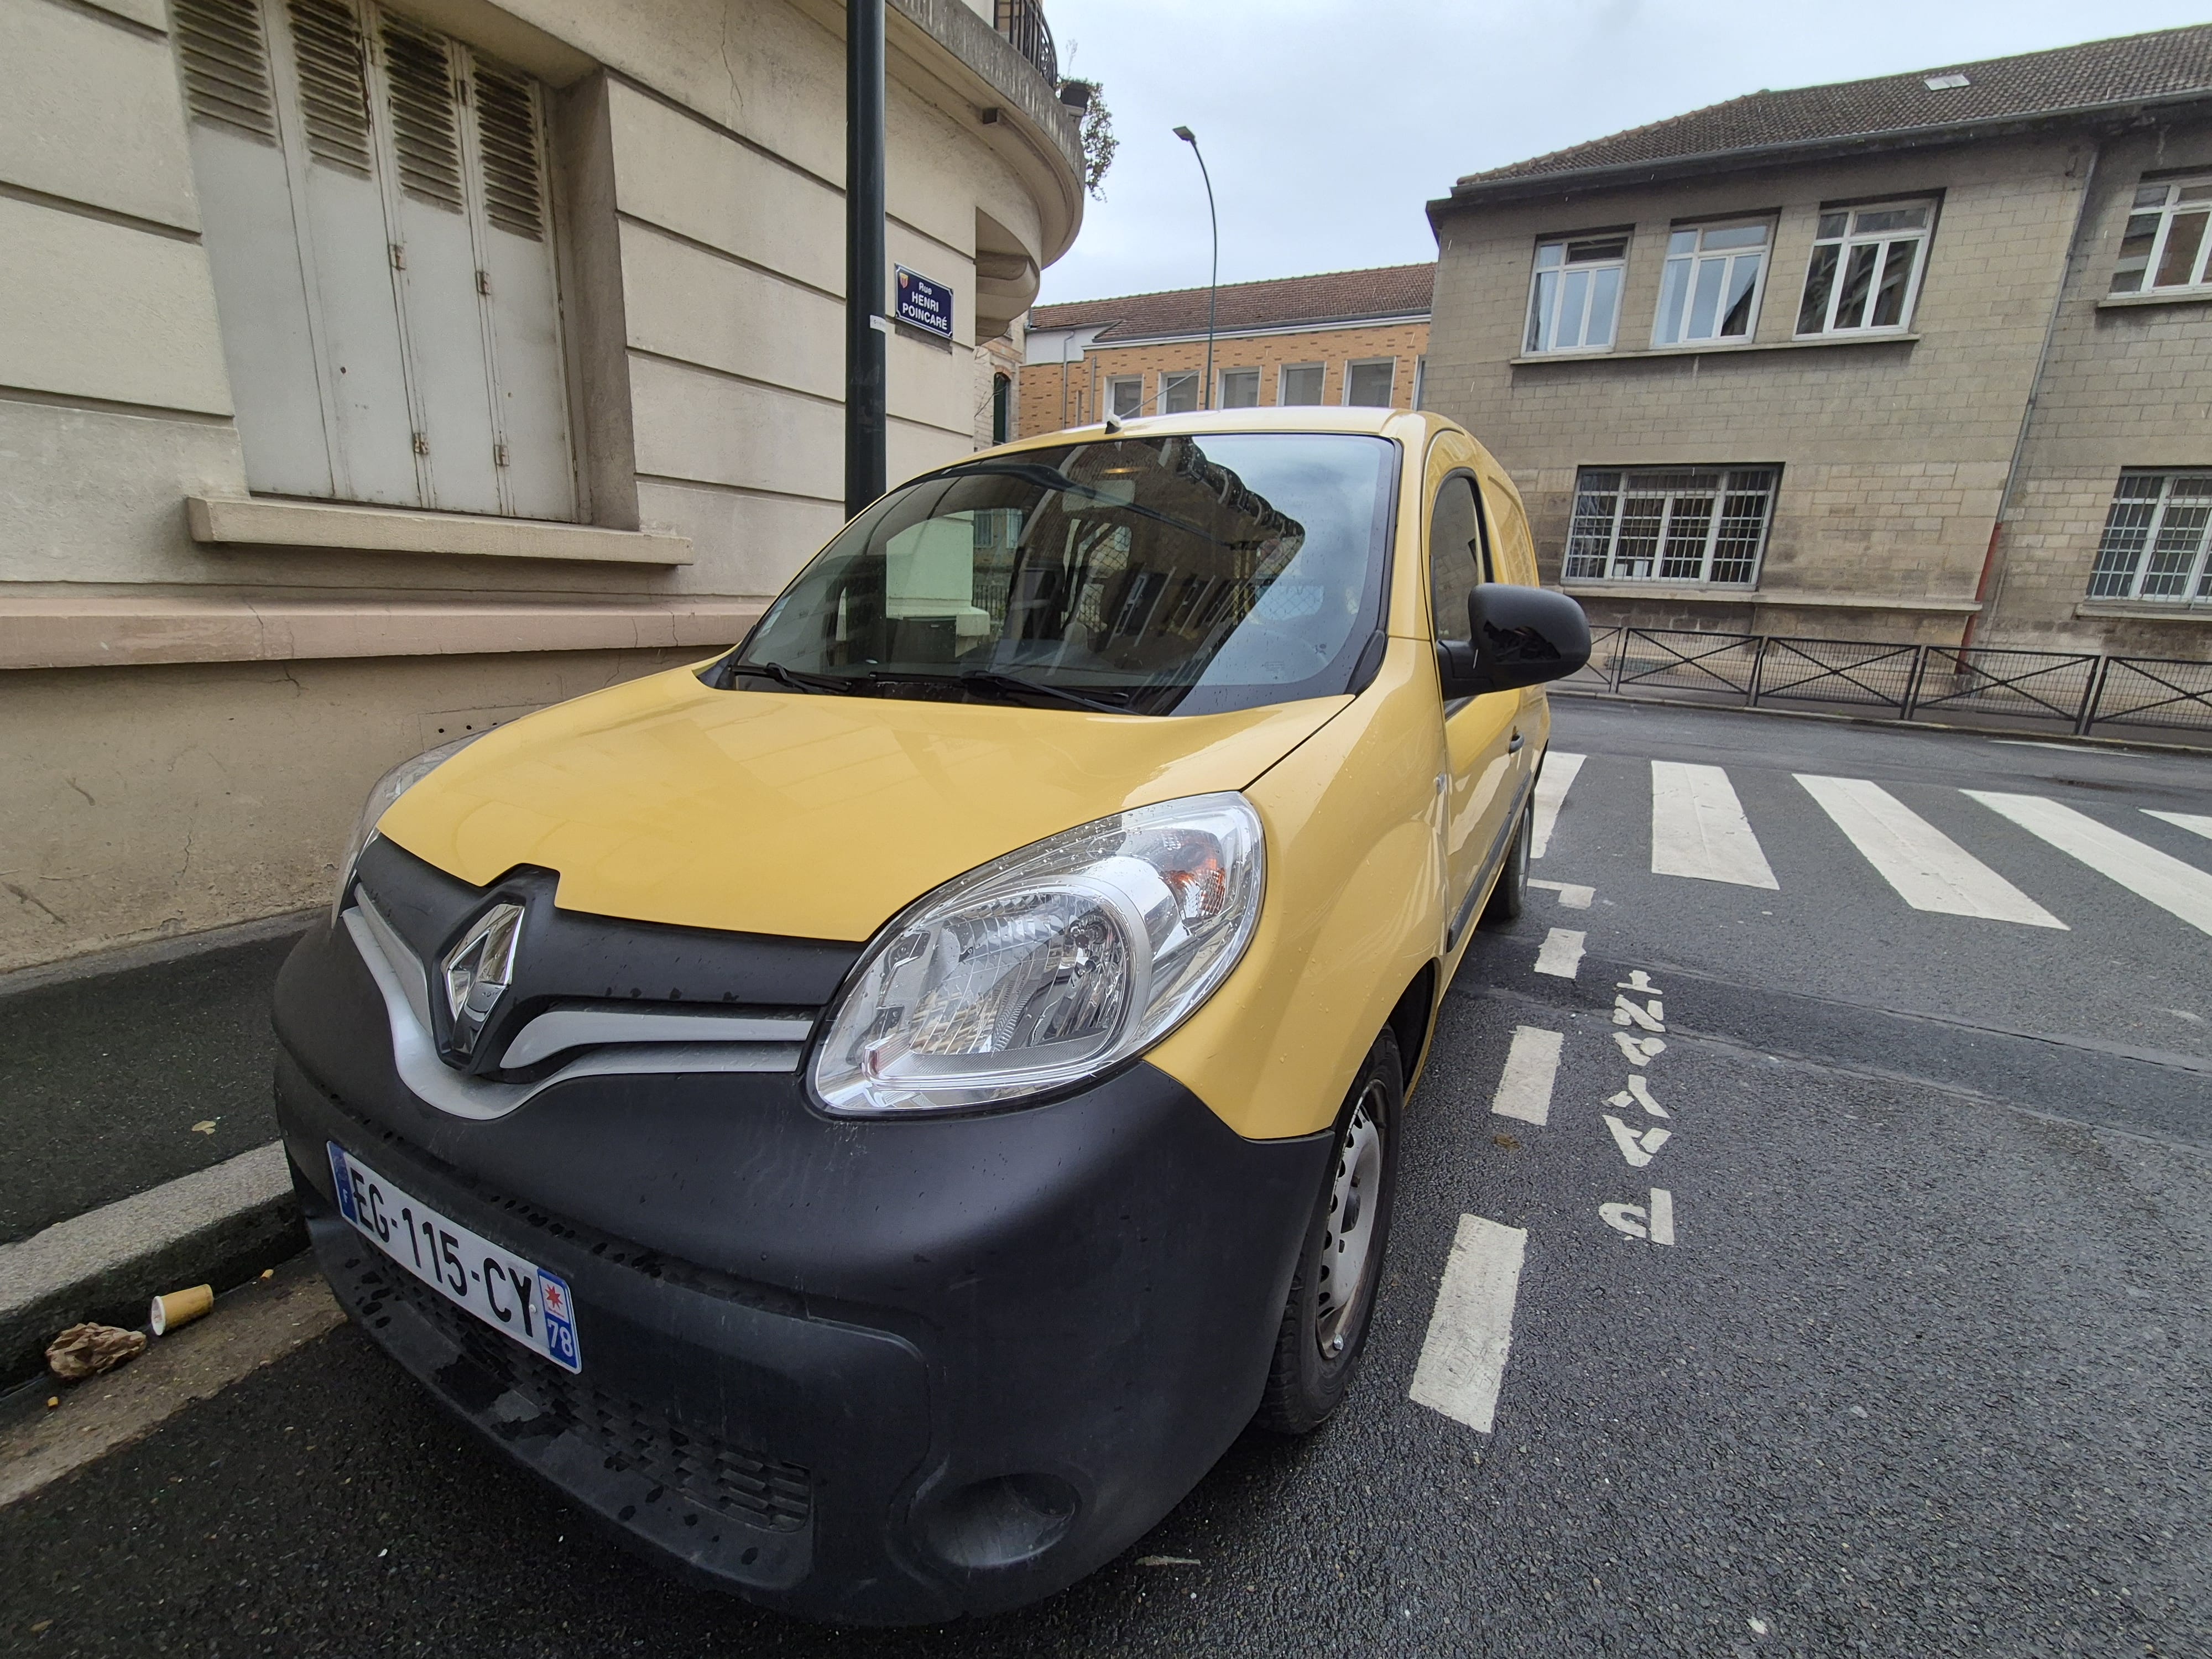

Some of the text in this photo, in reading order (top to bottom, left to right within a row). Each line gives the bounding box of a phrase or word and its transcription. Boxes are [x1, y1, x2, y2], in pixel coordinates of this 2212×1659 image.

[911, 291, 939, 312] HENRI
[919, 281, 932, 294] Rue
[902, 302, 947, 330] POINCARÉ
[1598, 969, 1674, 1246] PAYANT
[342, 1188, 348, 1203] F
[350, 1167, 534, 1338] EG-115-CY
[547, 1320, 573, 1357] 78
